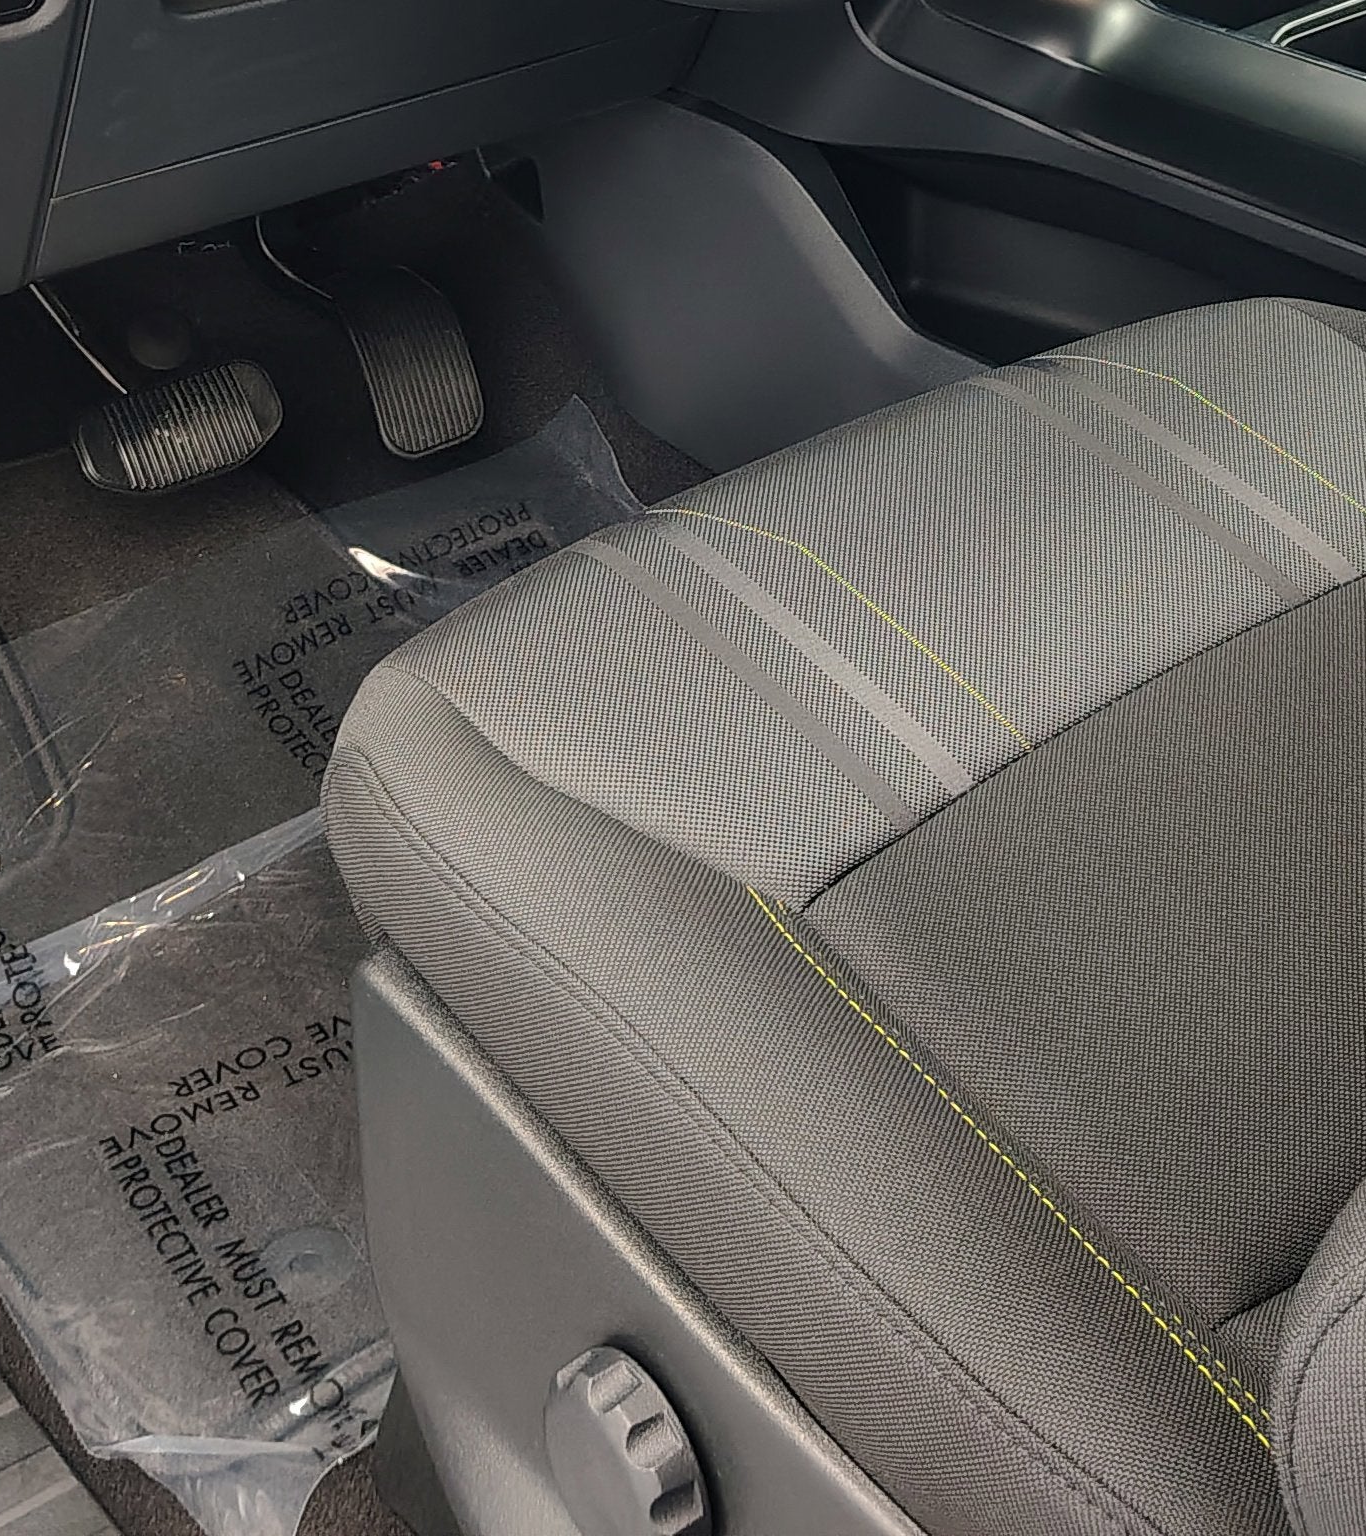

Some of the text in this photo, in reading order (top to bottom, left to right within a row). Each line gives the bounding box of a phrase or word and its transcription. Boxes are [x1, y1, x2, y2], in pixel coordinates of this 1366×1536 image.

[283, 502, 532, 625] PROTECTIV COVER
[452, 529, 547, 578] DEALER
[232, 613, 353, 685] REMOVE
[279, 670, 340, 744] DEALE
[99, 1044, 352, 1159] UST REMOVE
[168, 1036, 292, 1097] COVER
[156, 1136, 230, 1229] DEALER
[216, 1238, 286, 1311] MUST
[110, 1155, 281, 1408] PROTECTIVE COVER
